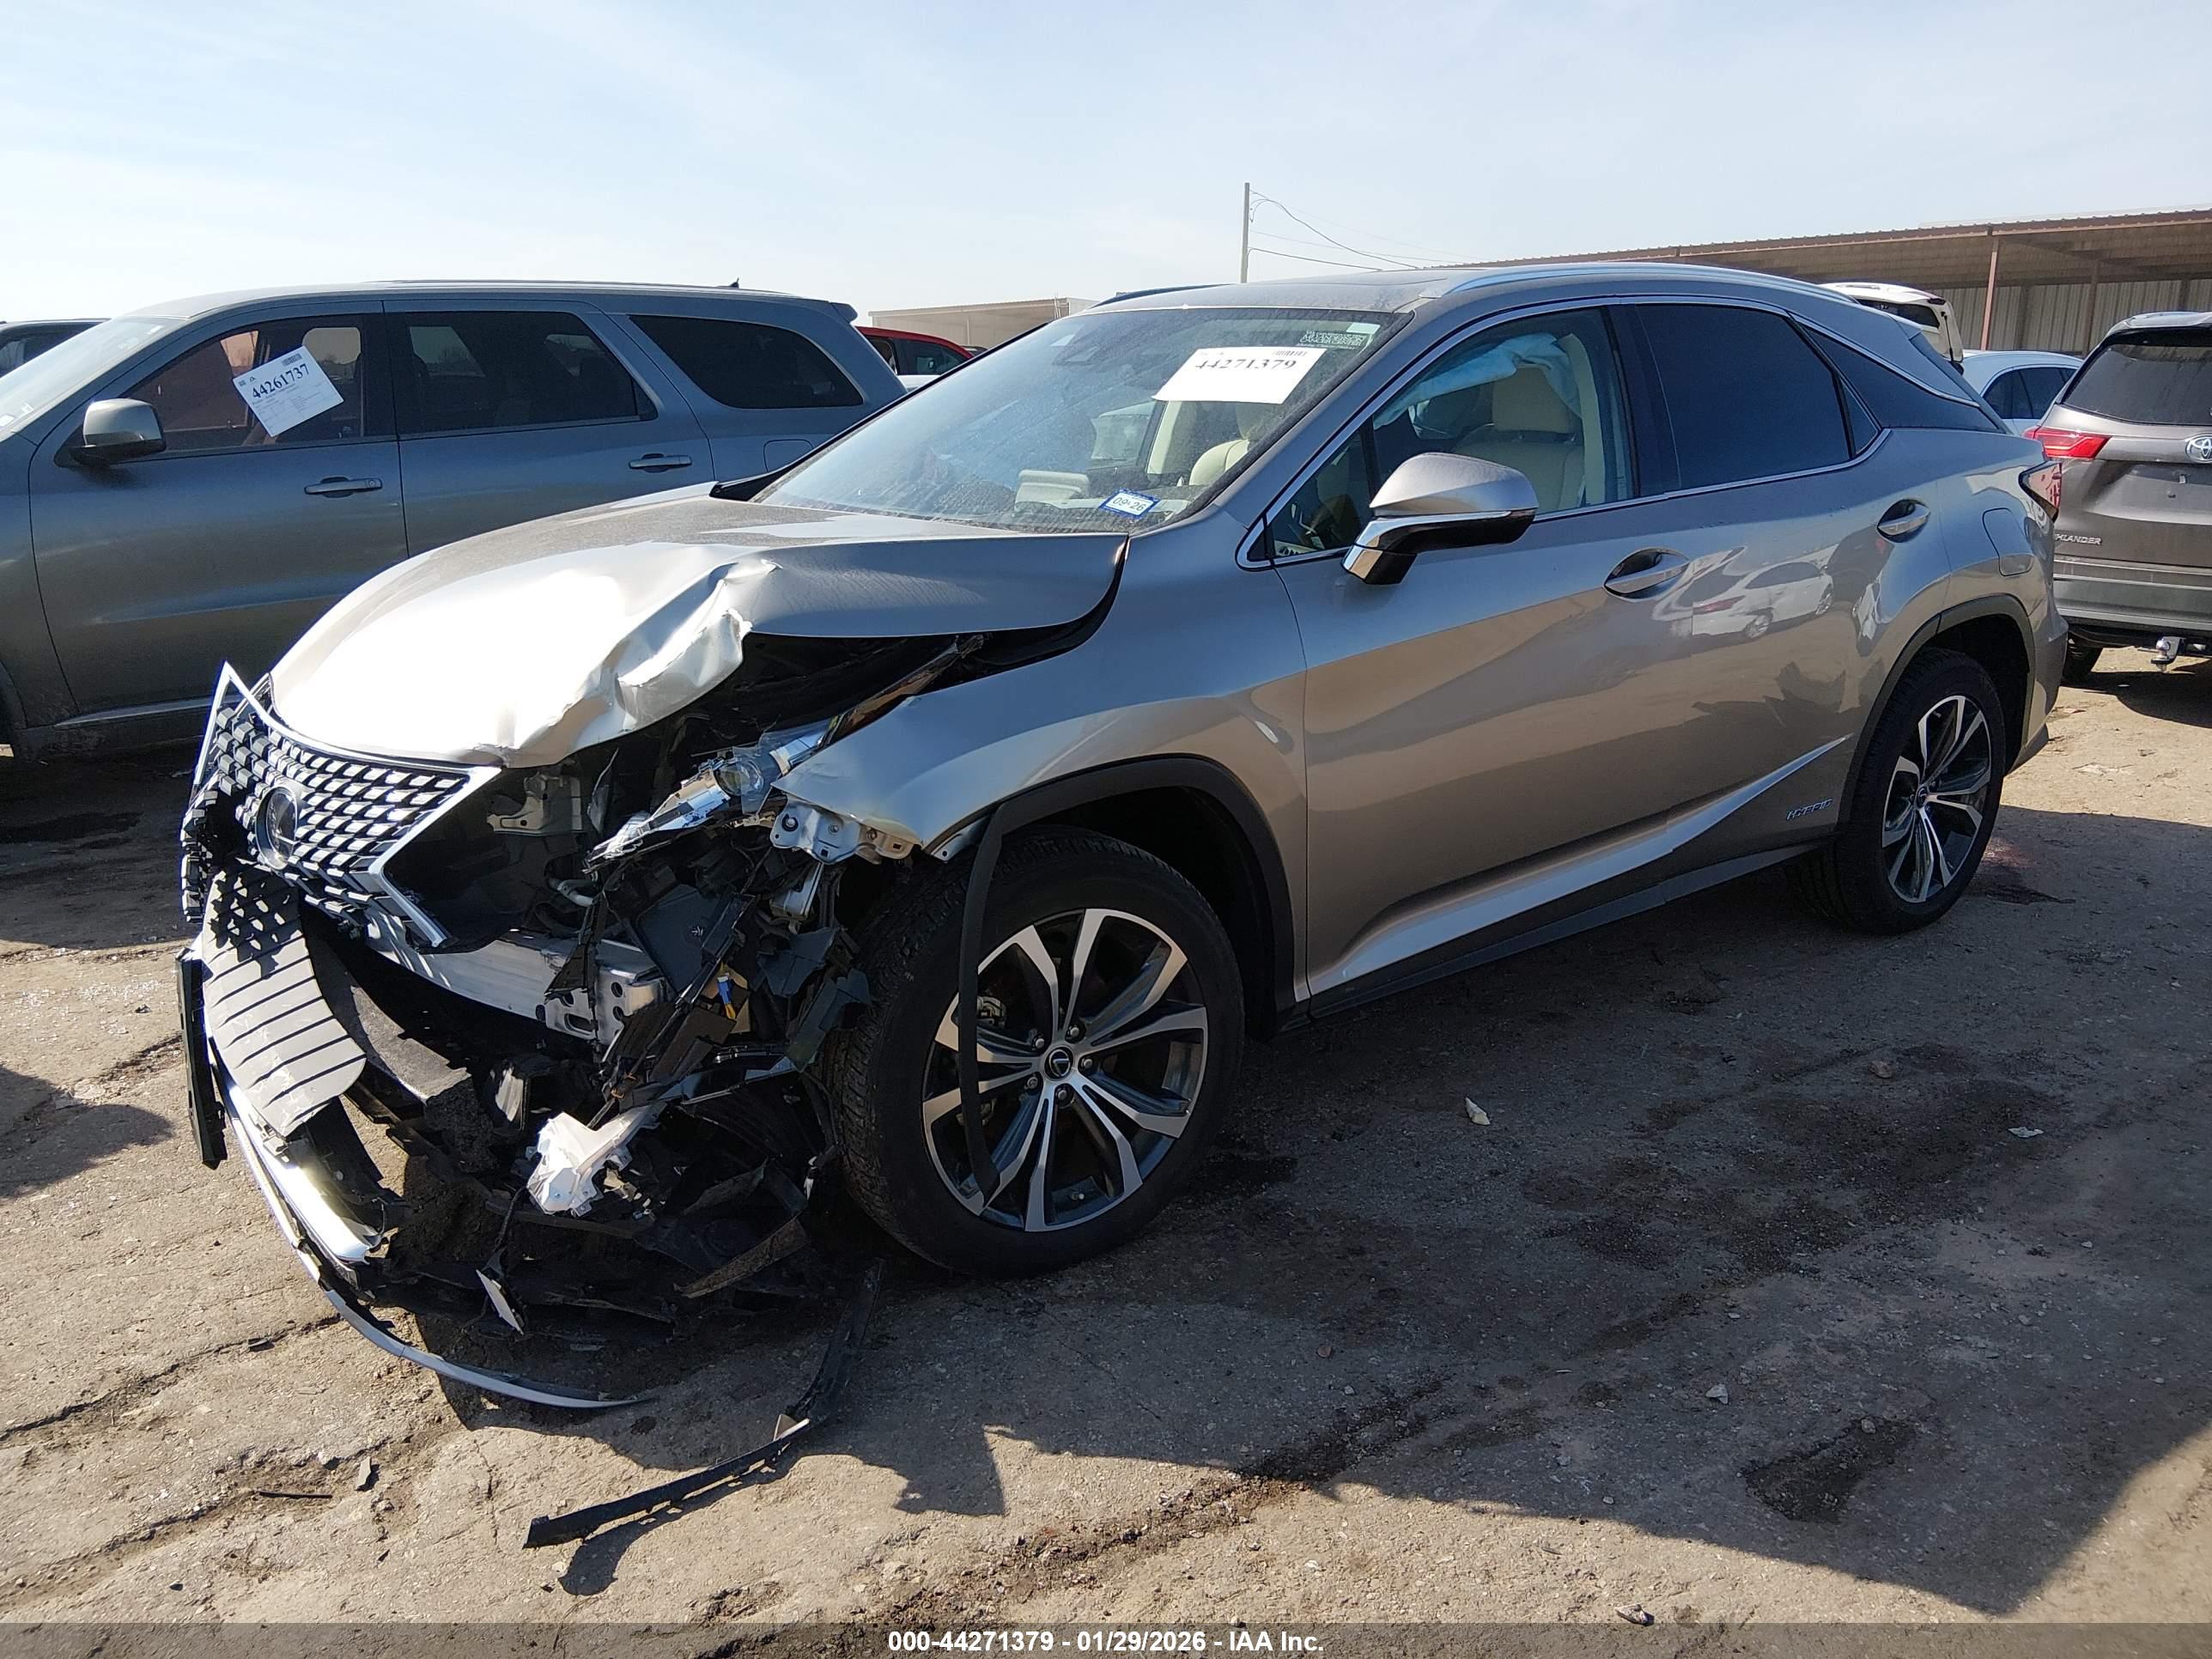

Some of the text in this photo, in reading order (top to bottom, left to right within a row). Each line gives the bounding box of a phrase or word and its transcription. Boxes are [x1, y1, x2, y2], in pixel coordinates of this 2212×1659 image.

[1194, 358, 1297, 370] 44271379
[252, 363, 310, 398] 44261737
[2053, 533, 2102, 545] HLANDER
